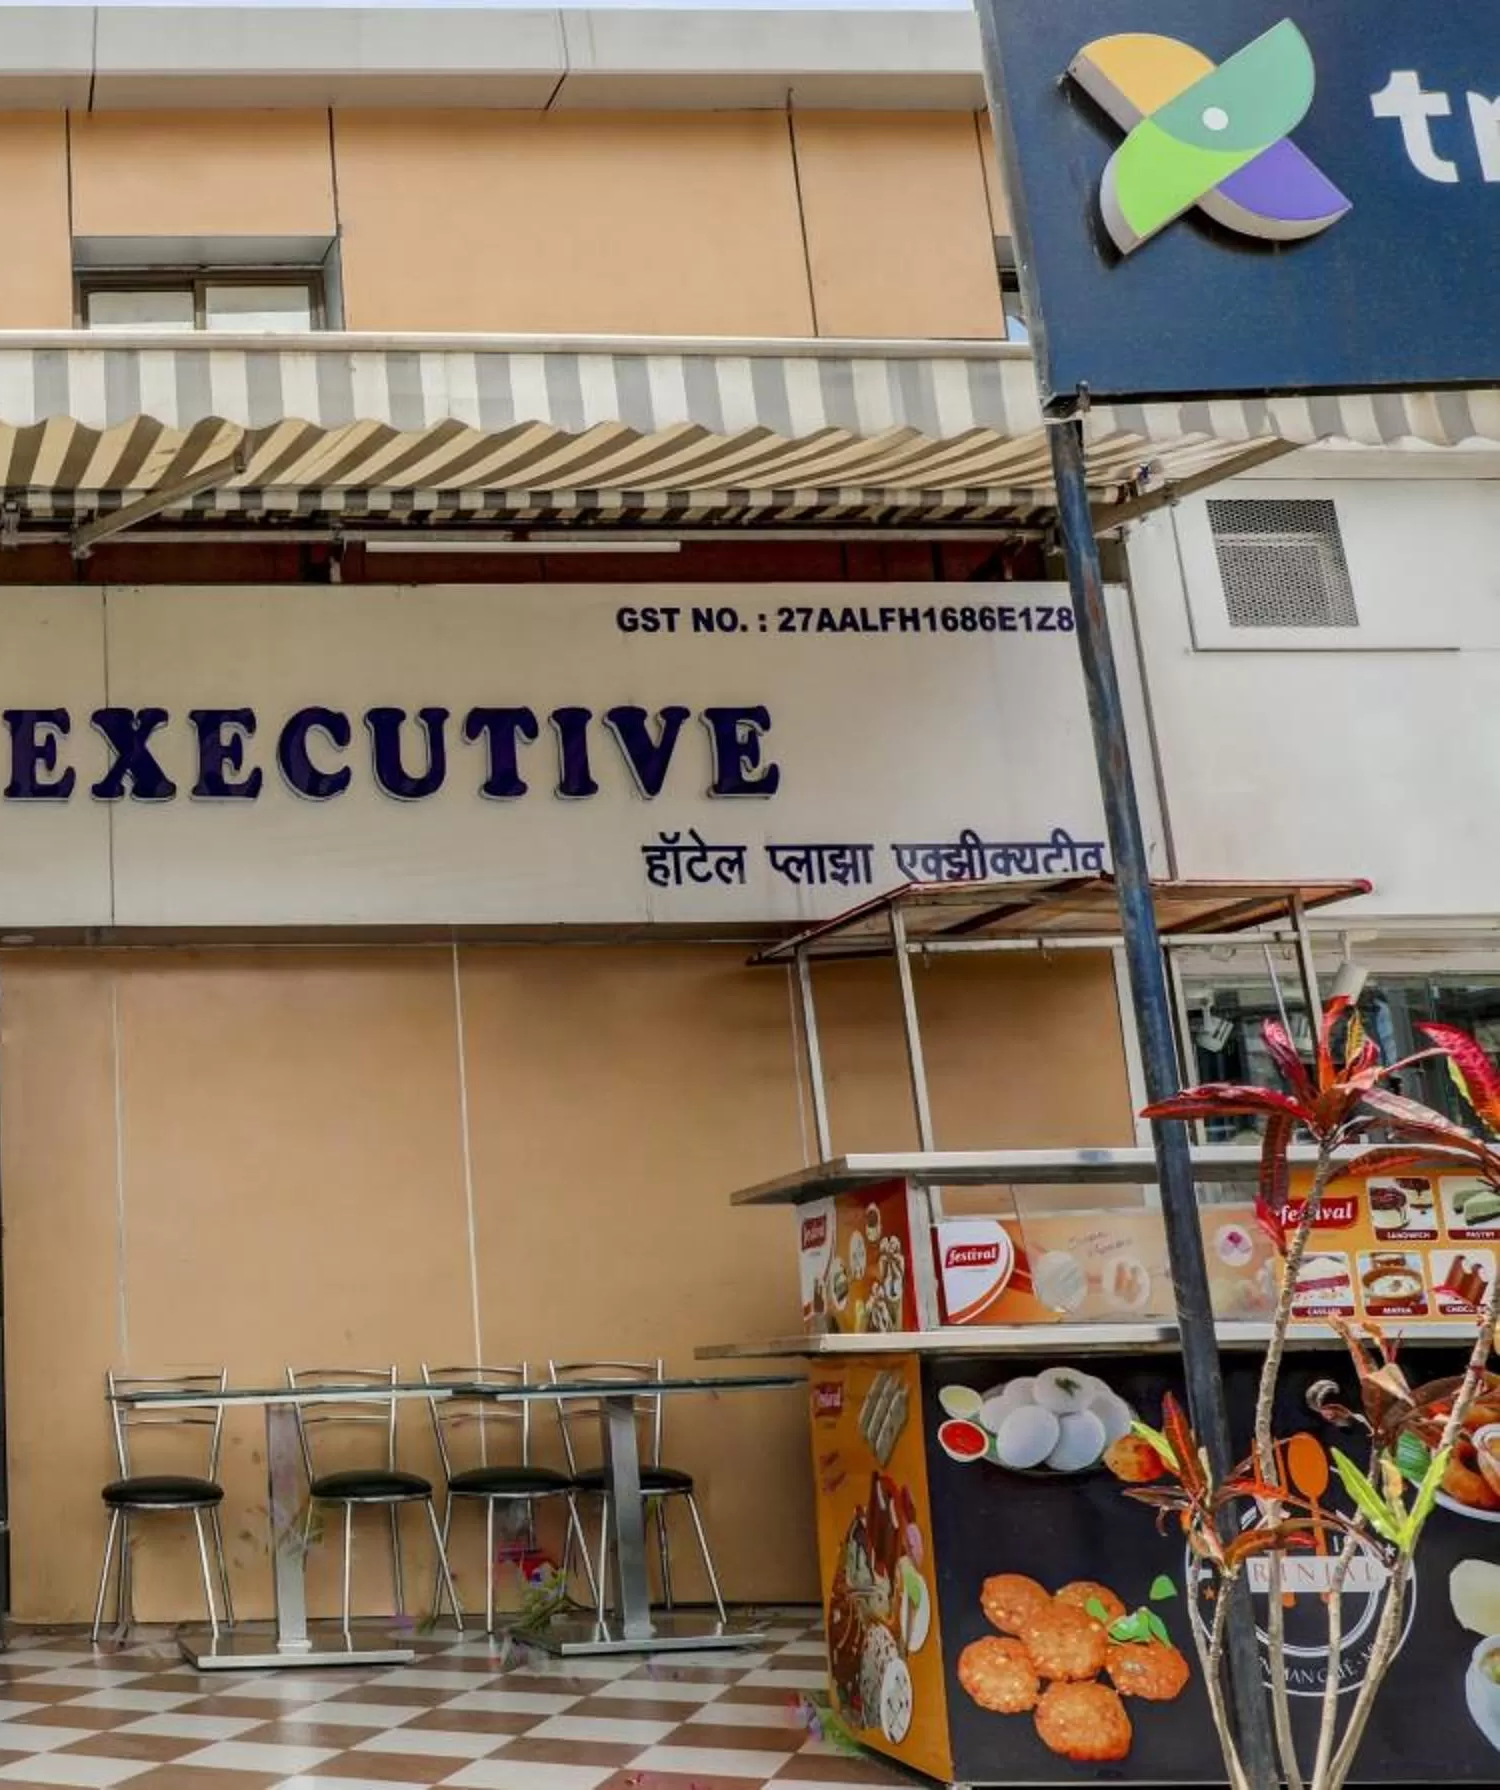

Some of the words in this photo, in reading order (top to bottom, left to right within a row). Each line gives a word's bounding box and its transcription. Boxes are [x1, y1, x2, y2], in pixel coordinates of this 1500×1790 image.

[616, 607, 680, 633] GST
[777, 606, 1076, 632] 27AALFH1686E1Z8
[1, 705, 780, 803] EXECUTIVE
[642, 829, 746, 886] हॉटेल
[765, 844, 873, 885] प्लाझा
[1281, 1202, 1352, 1226] feival
[949, 1247, 997, 1264] festival
